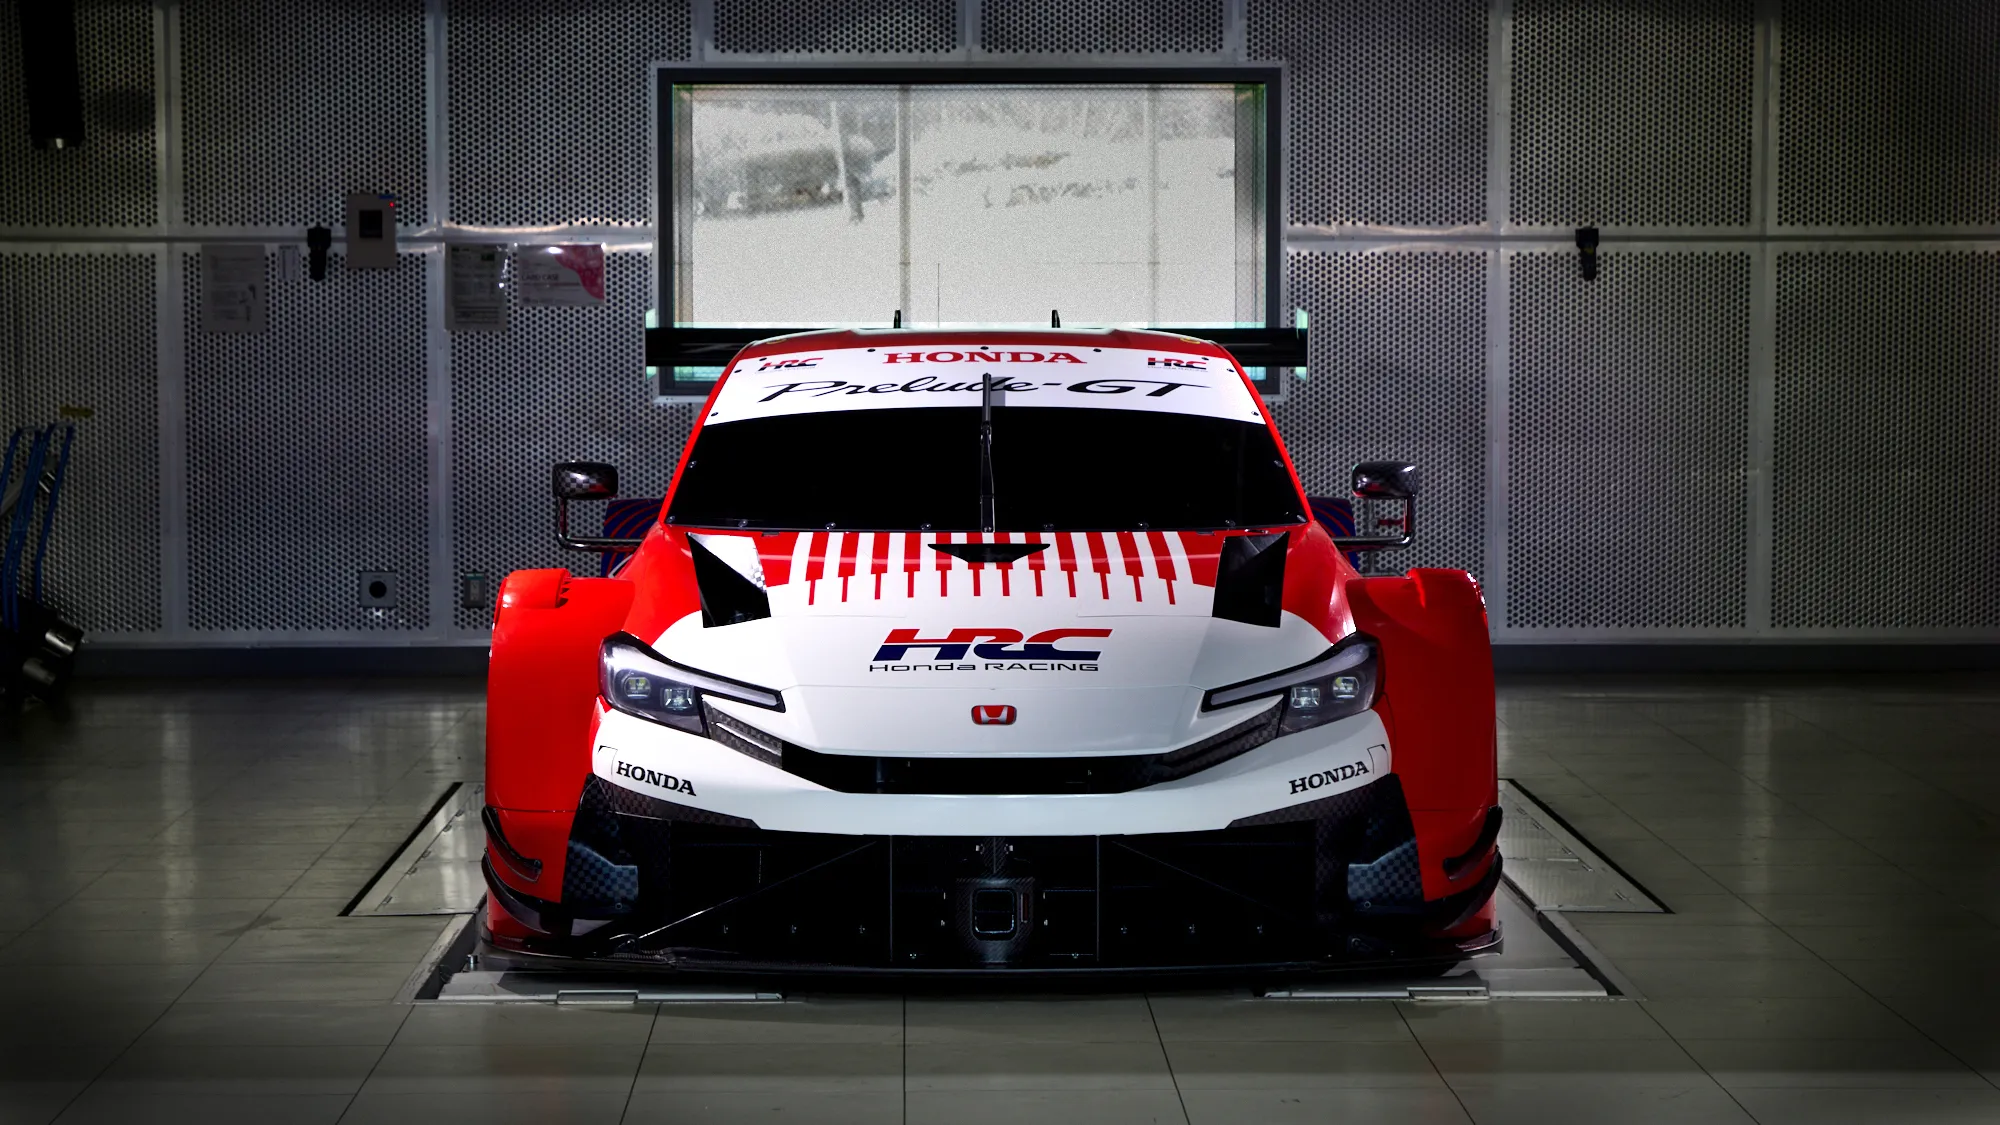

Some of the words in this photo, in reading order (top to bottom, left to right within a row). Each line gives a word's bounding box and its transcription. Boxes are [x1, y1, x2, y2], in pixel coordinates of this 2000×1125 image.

[758, 357, 823, 371] HRC
[883, 351, 1087, 364] HONDA
[1147, 357, 1207, 370] HRC
[757, 375, 1211, 404] Prelude-GT
[872, 628, 1113, 662] HRC
[869, 662, 977, 673] Honda
[984, 662, 1099, 672] RACING
[616, 760, 697, 797] HONDA
[1288, 760, 1370, 795] HONDA
